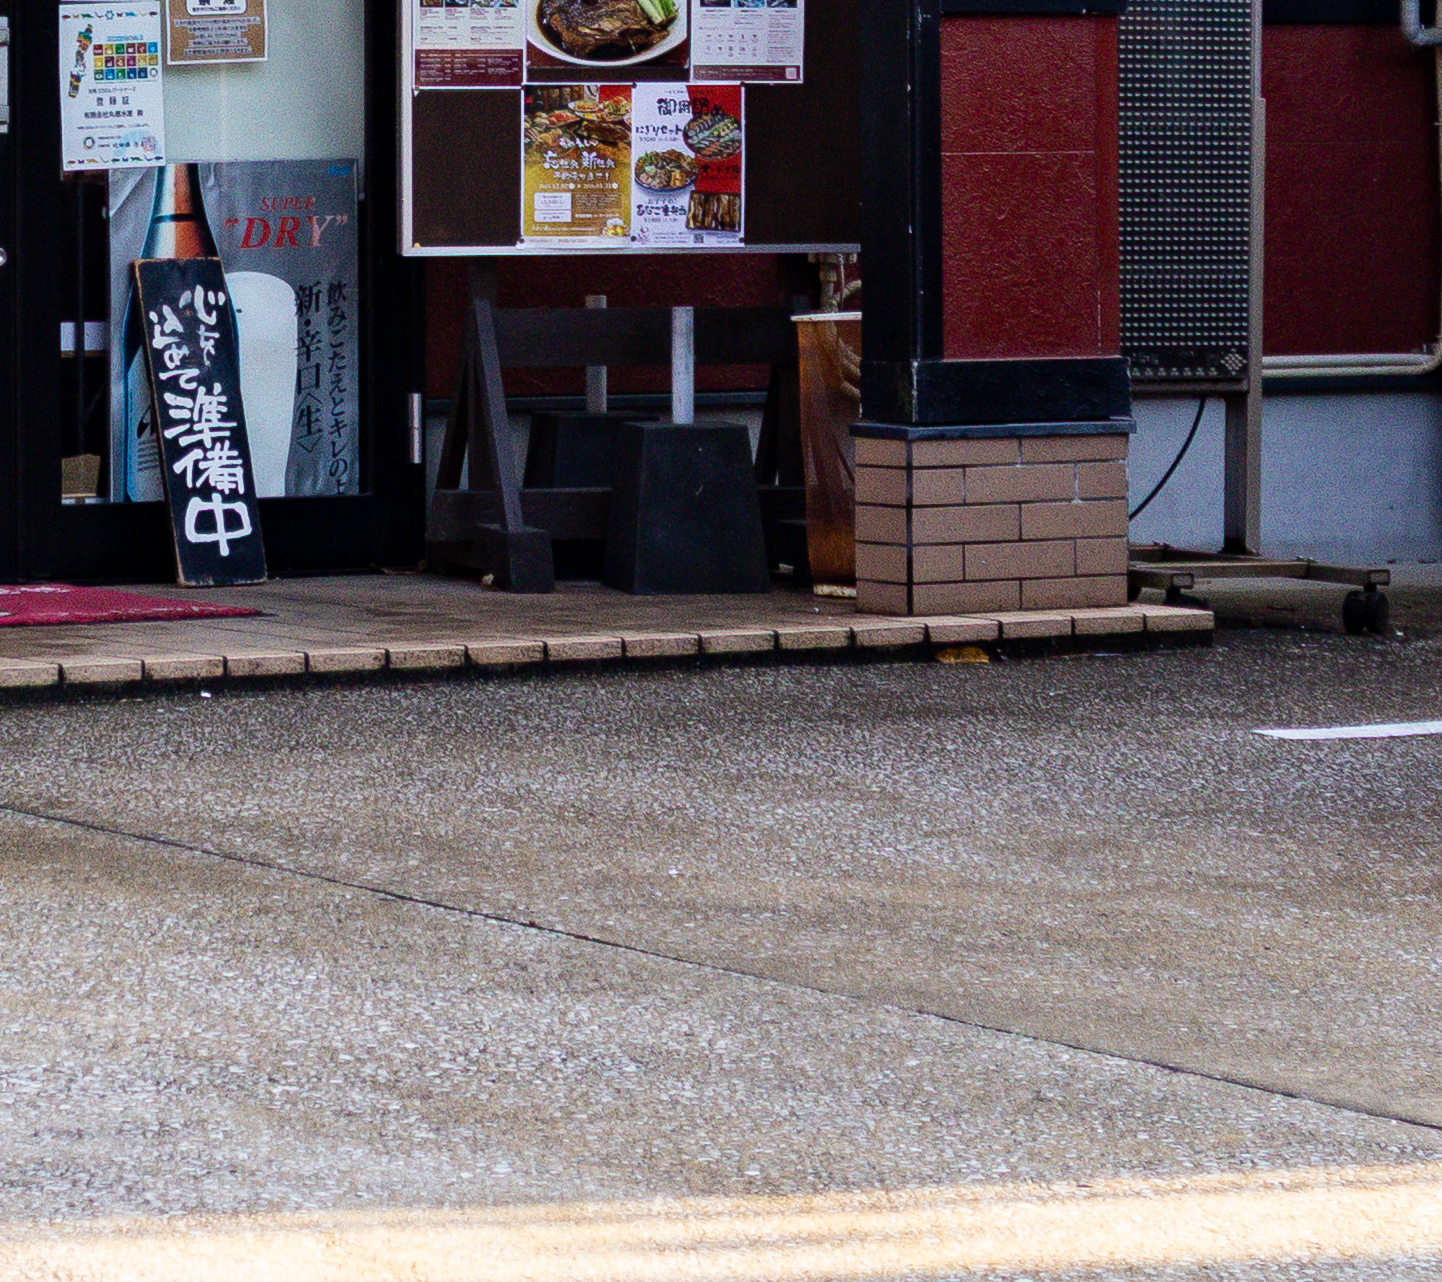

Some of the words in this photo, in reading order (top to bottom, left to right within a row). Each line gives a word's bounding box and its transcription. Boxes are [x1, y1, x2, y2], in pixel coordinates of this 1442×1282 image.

[259, 195, 317, 213] SUPER
[164, 381, 252, 557] 準備中
